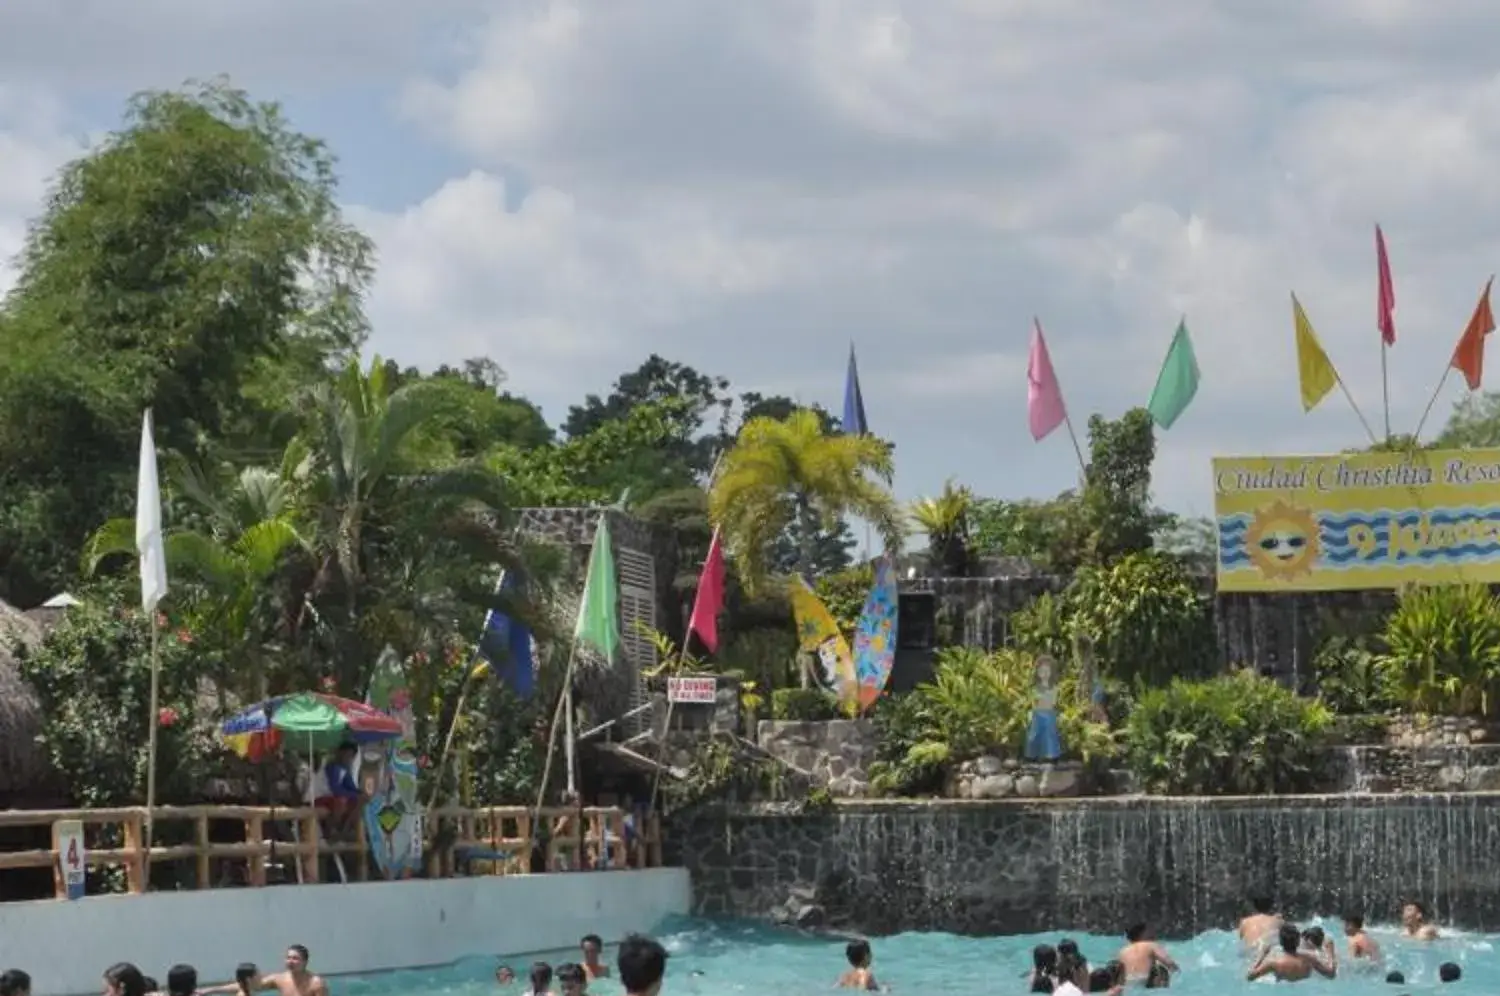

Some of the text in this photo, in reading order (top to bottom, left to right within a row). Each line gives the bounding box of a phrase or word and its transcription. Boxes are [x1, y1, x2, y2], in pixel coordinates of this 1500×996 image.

[1216, 464, 1307, 493] Ciudad
[1347, 523, 1377, 560] 9
[67, 838, 80, 868] 4
